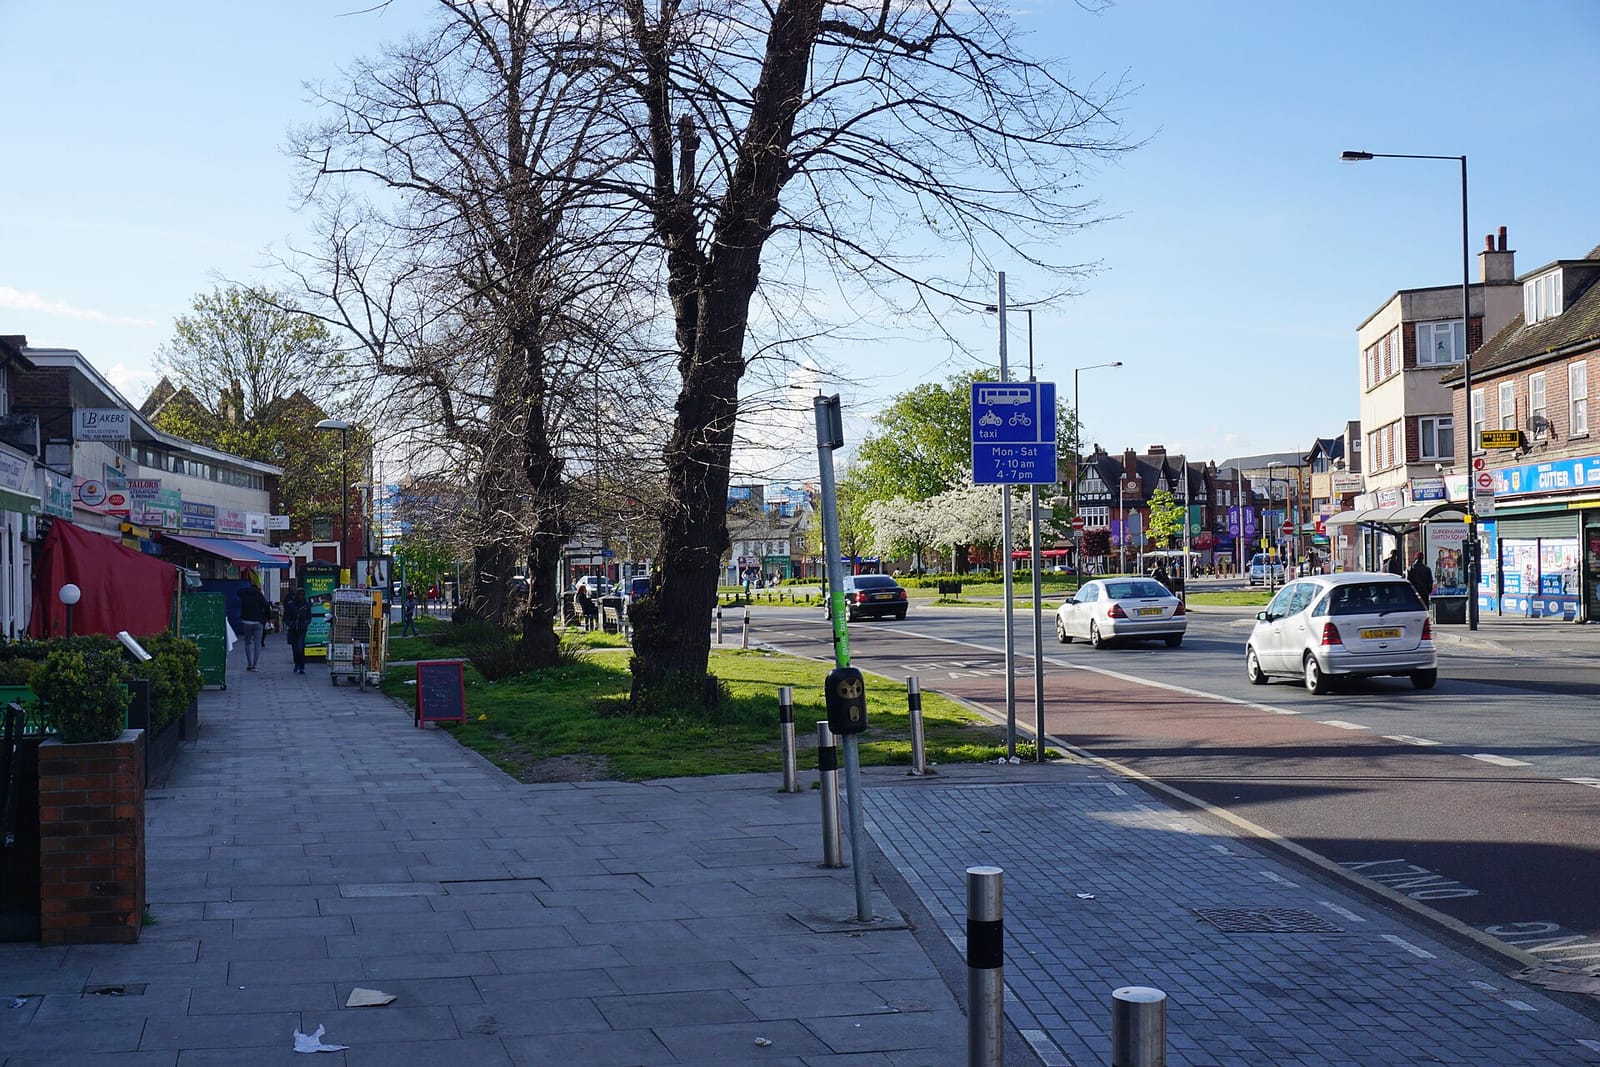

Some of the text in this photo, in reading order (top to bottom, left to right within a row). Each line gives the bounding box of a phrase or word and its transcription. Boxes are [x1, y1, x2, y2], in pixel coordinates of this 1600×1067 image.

[87, 412, 124, 424] BAKERS
[979, 429, 997, 438] taxi
[992, 447, 1013, 456] Mon
[1020, 447, 1038, 456] Sat
[1018, 471, 1033, 480] pm
[1539, 471, 1568, 488] CUTTER
[1337, 858, 1480, 900] ONLY
